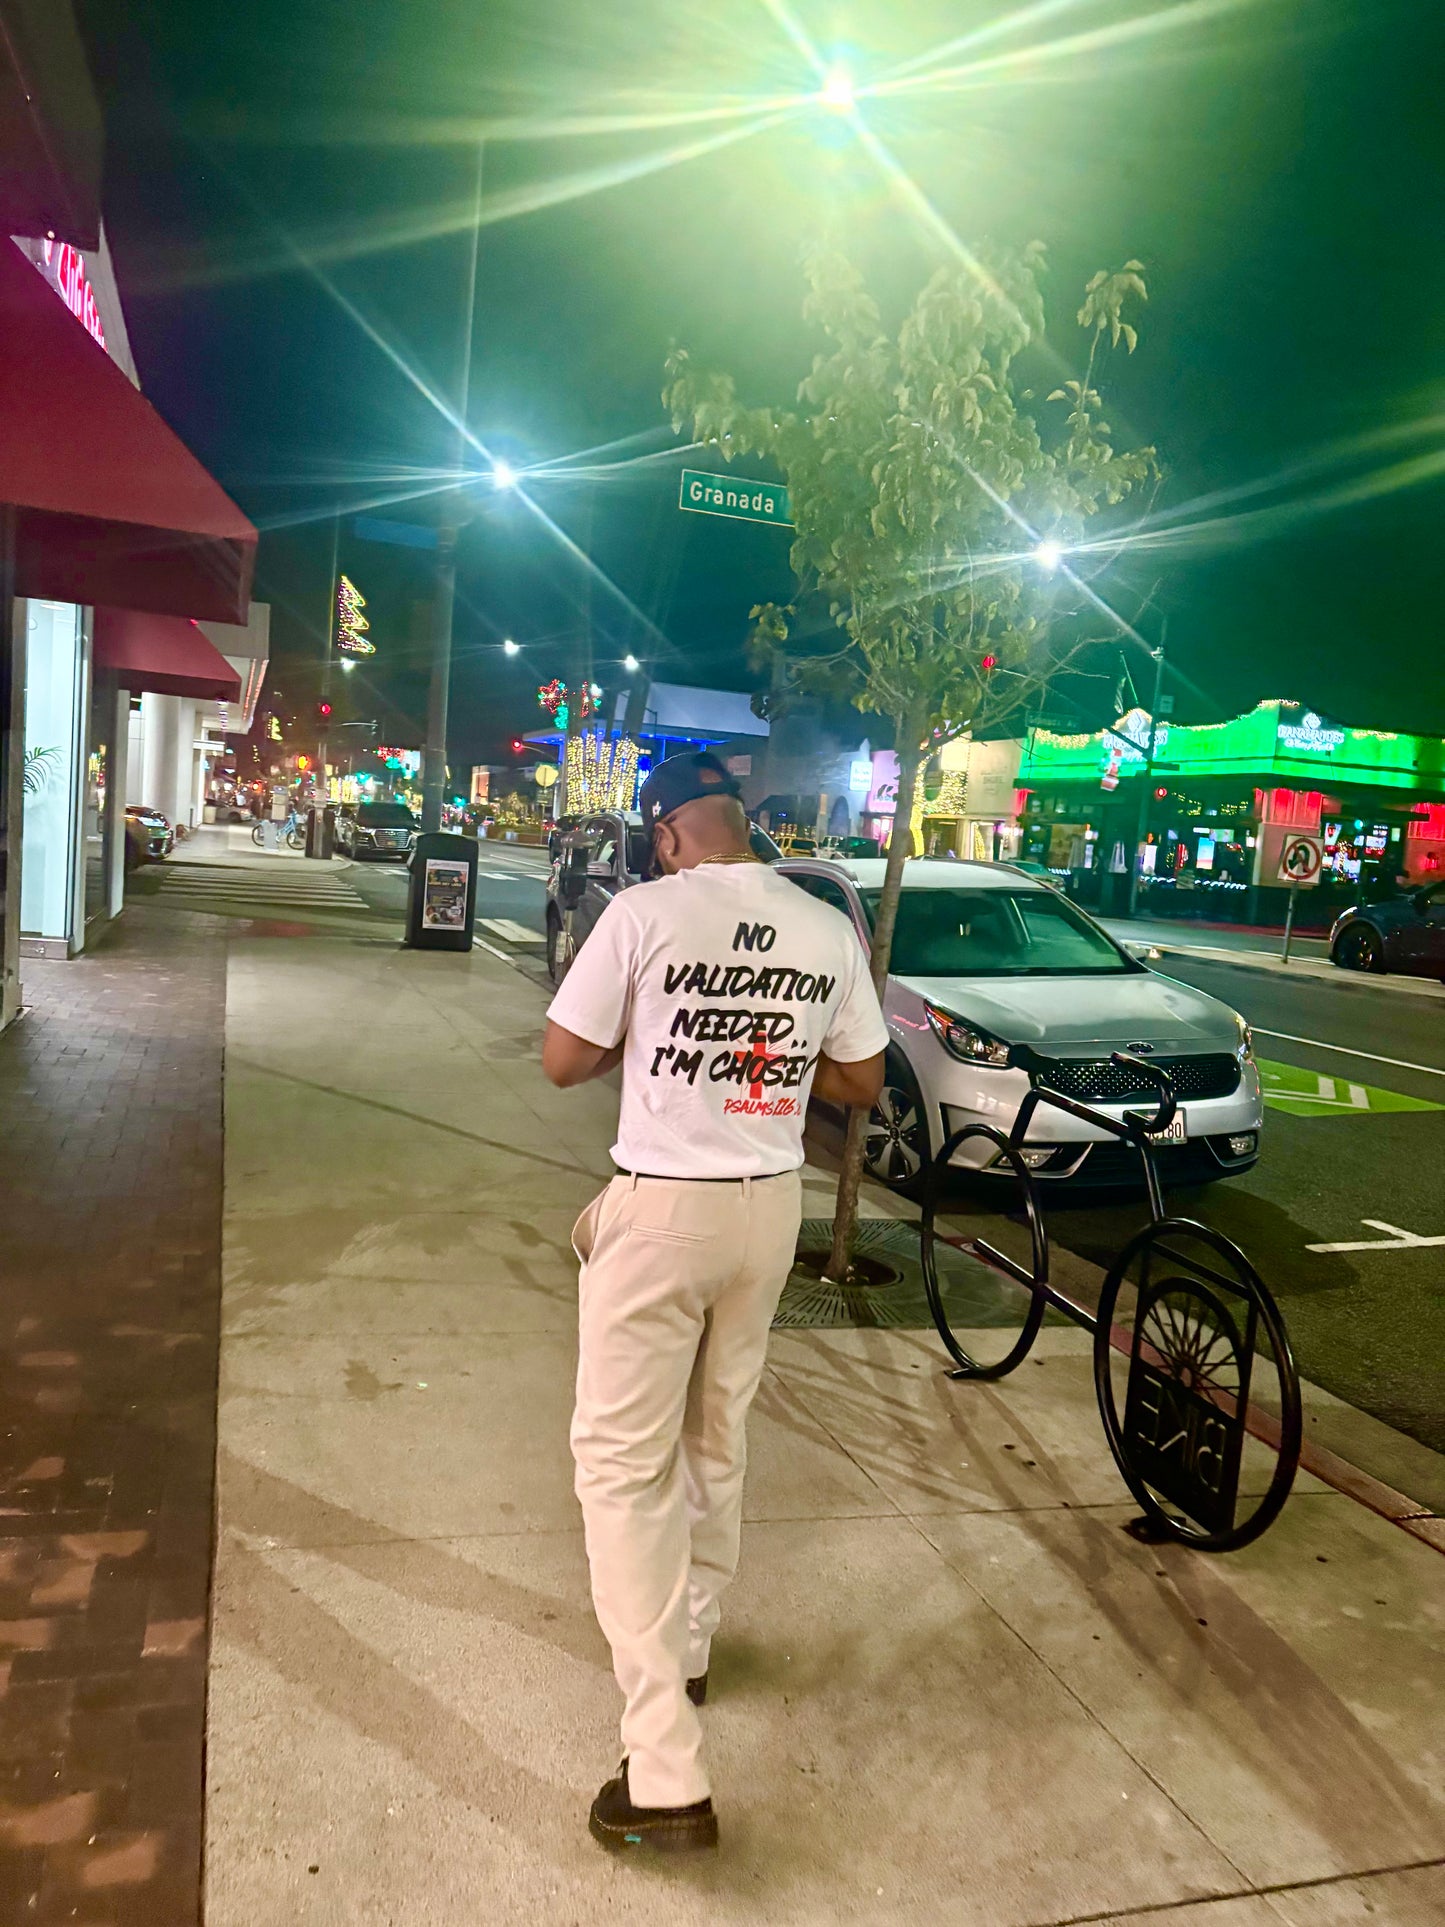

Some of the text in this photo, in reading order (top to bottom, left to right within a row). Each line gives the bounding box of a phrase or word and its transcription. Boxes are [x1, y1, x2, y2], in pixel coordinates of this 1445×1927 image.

[690, 481, 775, 513] Granada
[733, 922, 776, 952] NO
[665, 962, 835, 1004] VALIDATION
[650, 1046, 704, 1085] I'M
[724, 1098, 773, 1116] PSALMS
